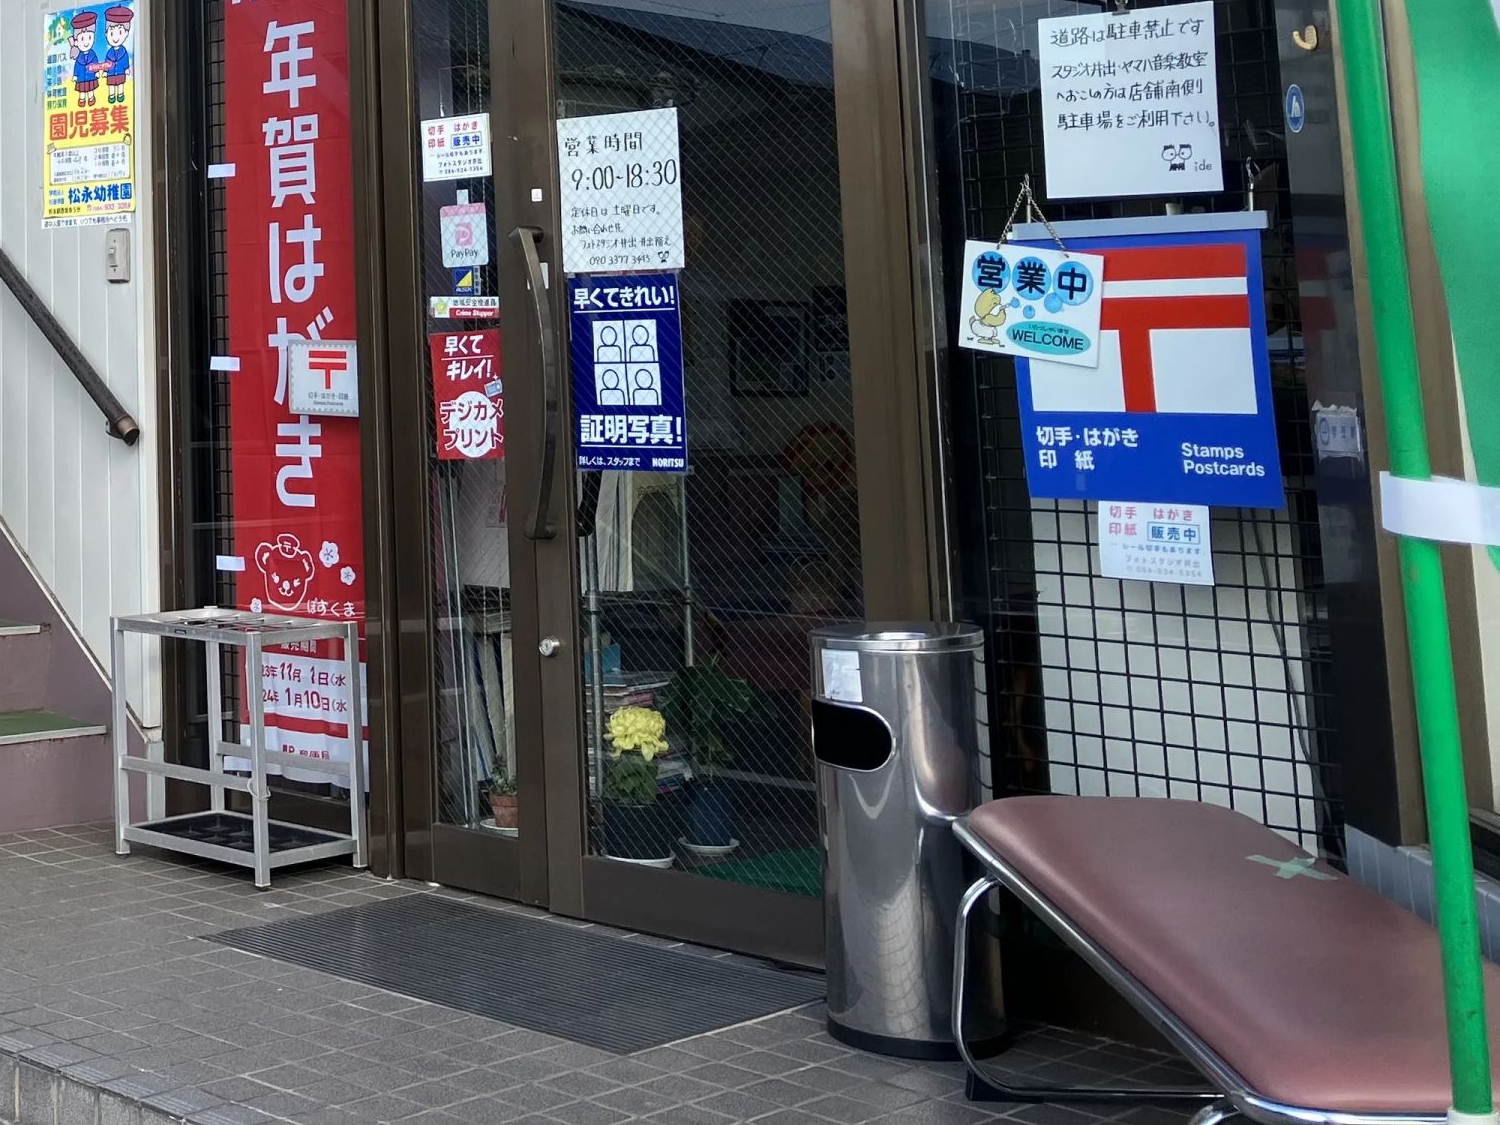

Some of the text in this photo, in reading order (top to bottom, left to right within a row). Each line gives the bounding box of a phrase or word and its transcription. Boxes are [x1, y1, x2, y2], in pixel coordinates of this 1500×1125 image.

[1050, 18, 1205, 48] 道路は駐車禁止です
[49, 104, 130, 141] 園児募集
[428, 124, 445, 136] 切手
[453, 134, 480, 147] 販売中
[564, 132, 643, 157] 営業時間
[1194, 159, 1212, 171] ide
[68, 183, 132, 205] 松永幼稚園
[263, 20, 334, 508] 年賀はがき
[451, 248, 478, 259] PayPay
[977, 254, 1087, 301] 営業中
[574, 285, 675, 309] 早くてきれい!
[444, 335, 483, 356] 早くて
[1012, 329, 1084, 351] WELCOME
[447, 358, 492, 381] キレイ!
[440, 398, 504, 424] デジカメ
[443, 427, 504, 450] プリント
[580, 414, 682, 444] 証明写真!
[1181, 442, 1245, 460] Stamps
[652, 457, 684, 468] NORITSU
[1183, 459, 1265, 477] Postcards
[1109, 505, 1193, 522] 切手 はがき
[1108, 522, 1197, 542] 印紙 販売中
